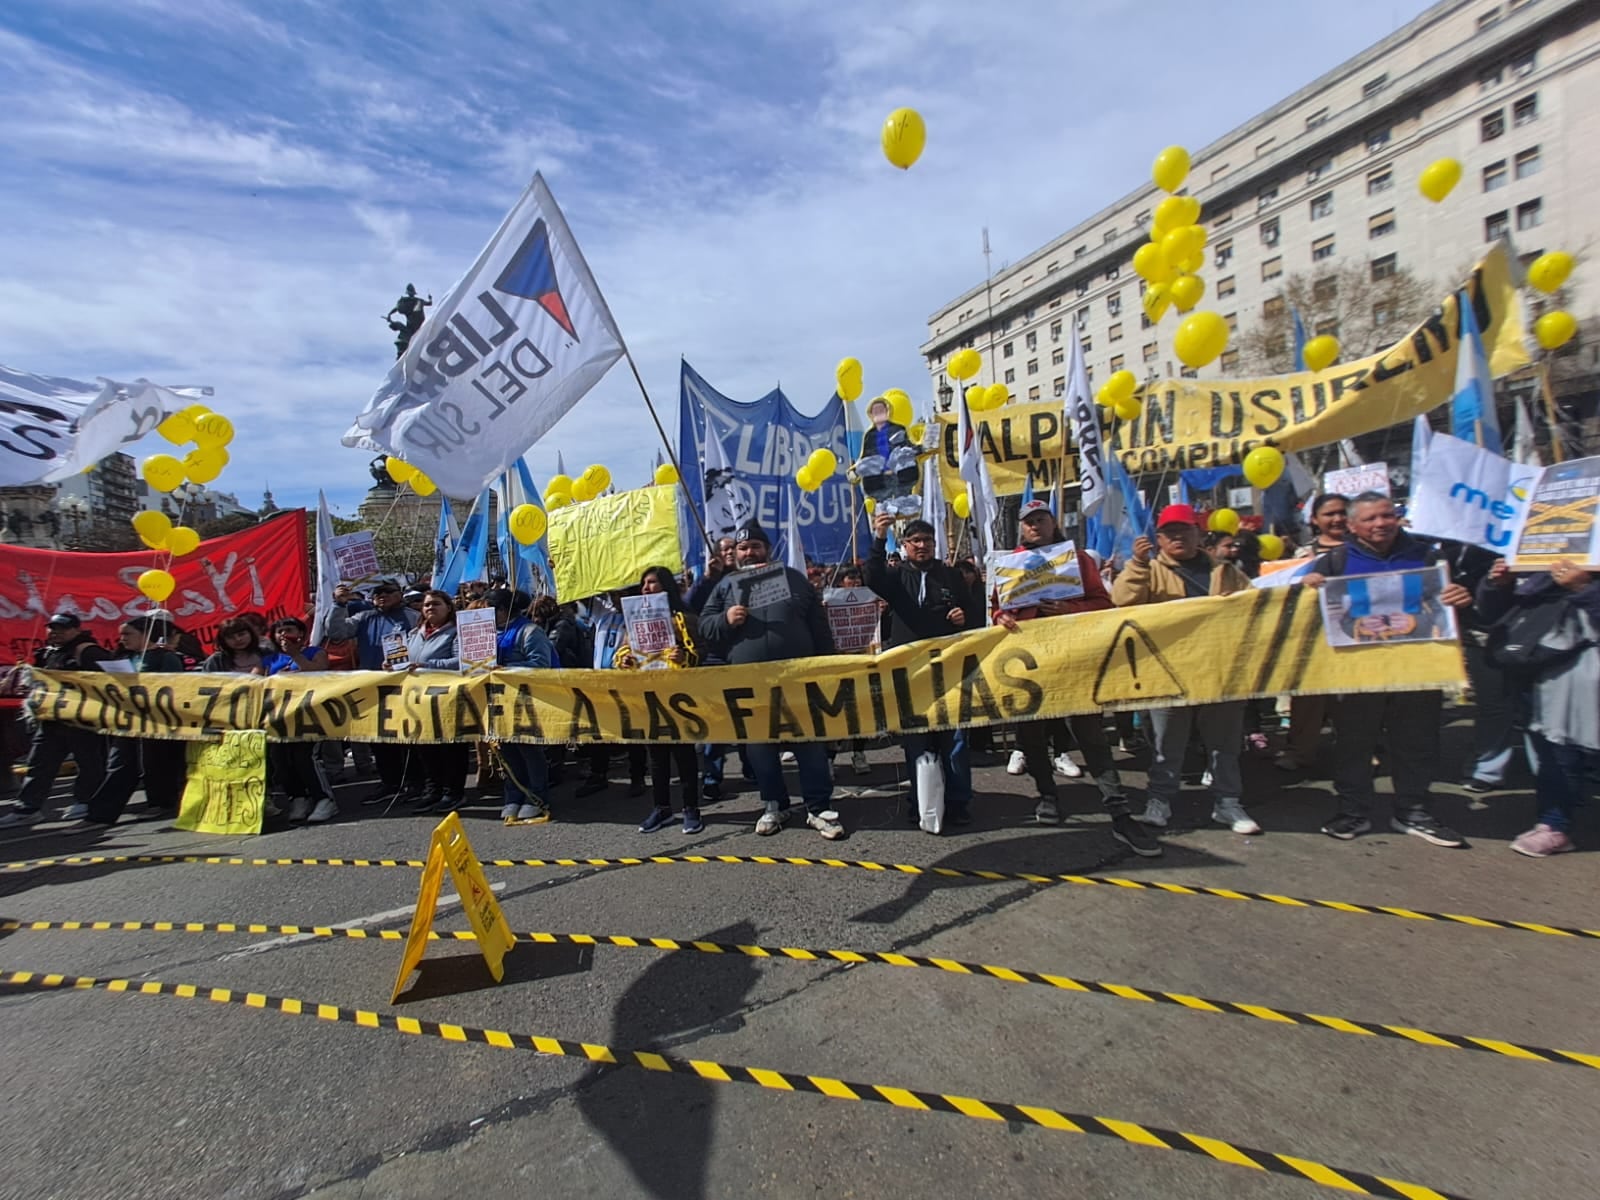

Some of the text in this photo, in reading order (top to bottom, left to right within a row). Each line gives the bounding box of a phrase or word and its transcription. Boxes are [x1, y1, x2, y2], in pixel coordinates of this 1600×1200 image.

[735, 423, 850, 477] LIBRES
[1026, 455, 1086, 488] MIL
[736, 480, 793, 529] DEL
[635, 620, 667, 634] ES UNA
[637, 631, 670, 645] ESTAFA
[198, 685, 329, 738] ZONA
[321, 687, 371, 728] DE
[376, 683, 546, 739] ESTAFA
[570, 686, 604, 740] A
[607, 687, 709, 742] LAS
[722, 647, 1044, 740] FAMILIAS
